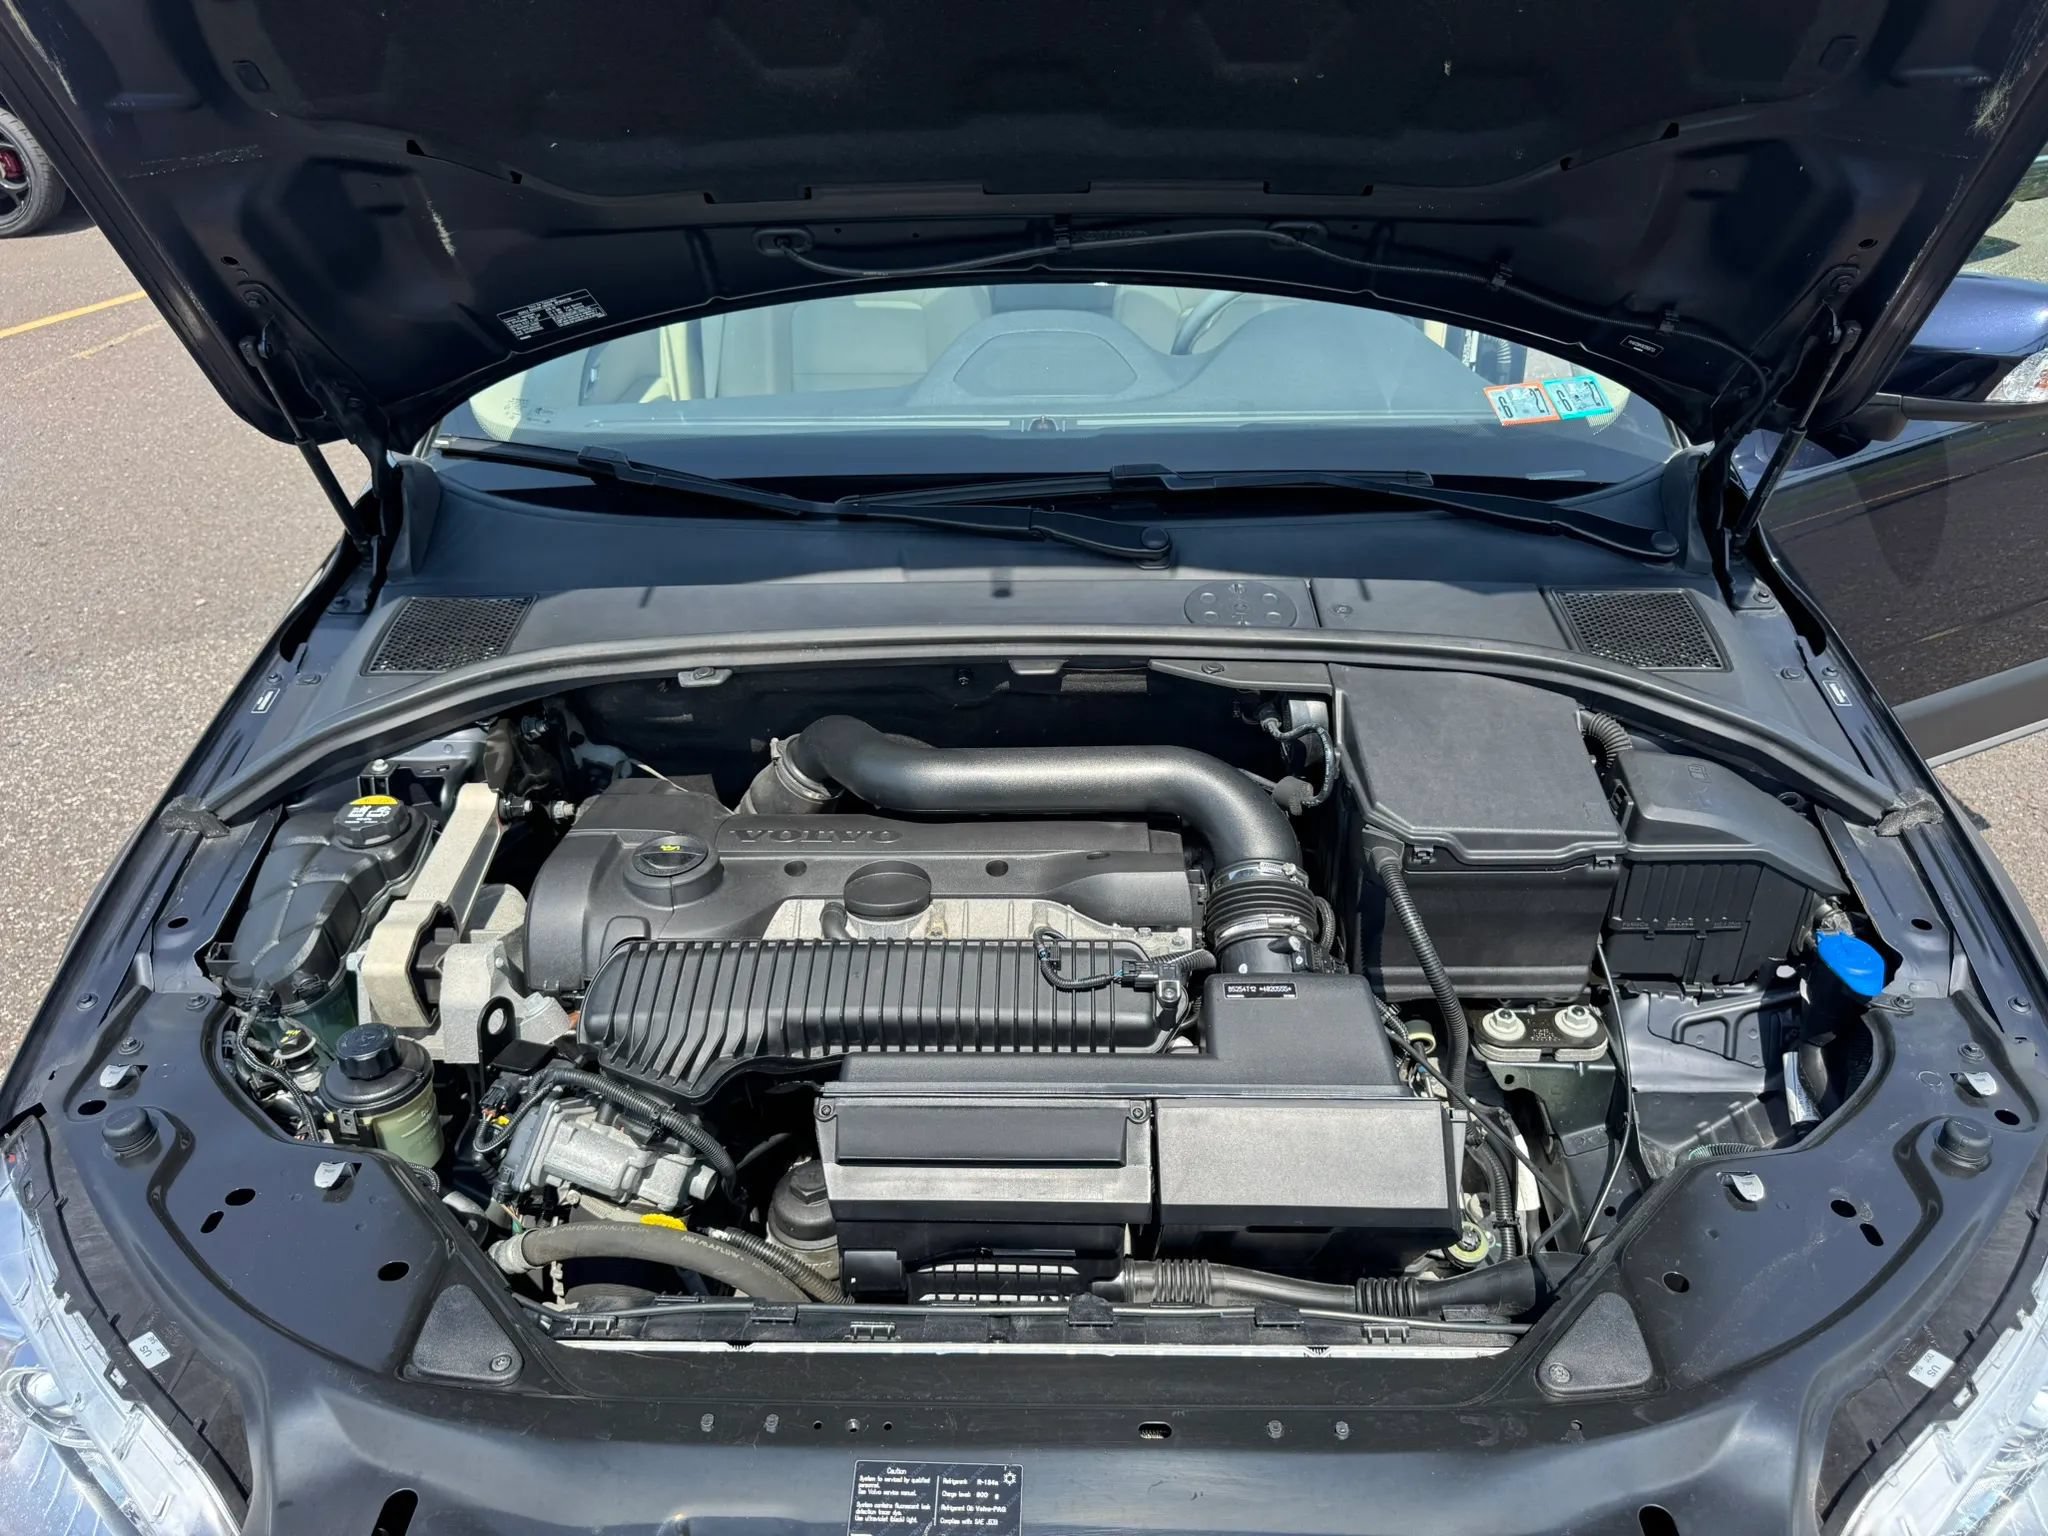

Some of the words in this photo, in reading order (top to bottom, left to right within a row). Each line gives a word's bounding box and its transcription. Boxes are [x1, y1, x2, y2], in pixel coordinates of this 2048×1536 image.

[729, 829, 903, 844] VOLVO
[140, 1345, 152, 1357] US
[1927, 1365, 1941, 1376] US
